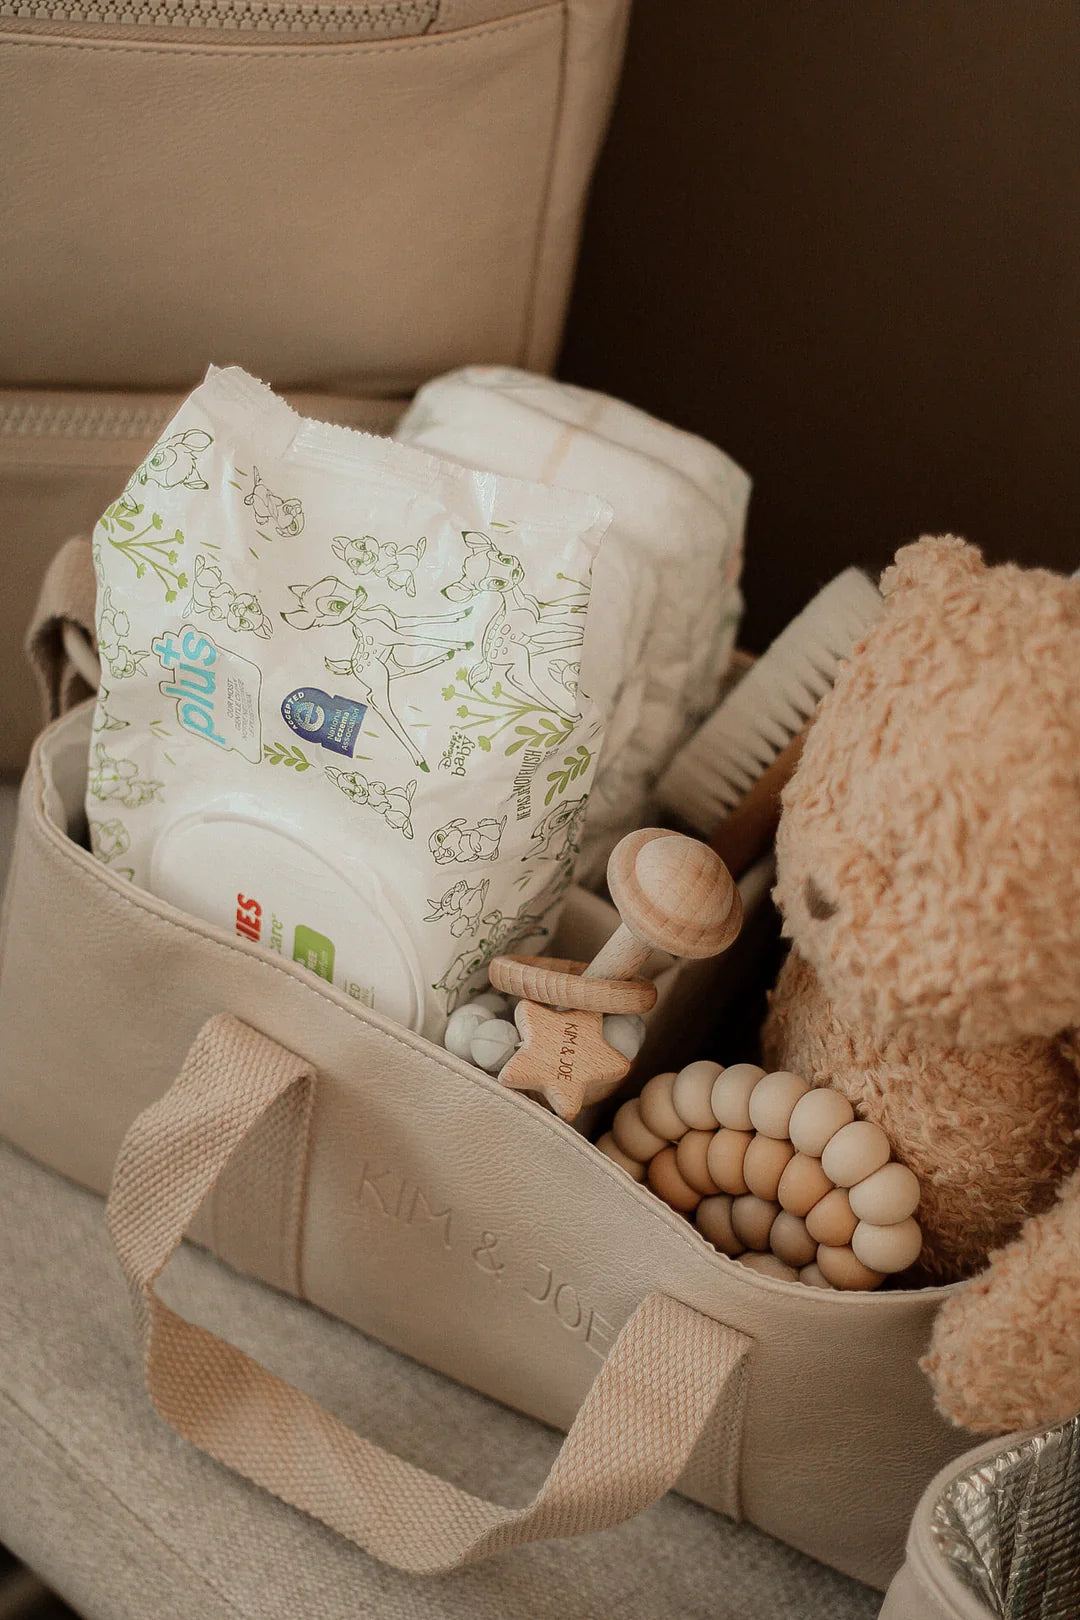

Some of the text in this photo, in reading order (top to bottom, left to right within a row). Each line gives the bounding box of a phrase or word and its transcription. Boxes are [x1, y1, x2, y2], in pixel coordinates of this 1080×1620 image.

[283, 691, 305, 730] ACCEPTED
[327, 708, 342, 740] National
[334, 711, 350, 743] Eczema
[342, 708, 360, 751] Association
[451, 735, 476, 777] baby
[519, 749, 543, 774] FLUSH
[236, 892, 263, 943] IES
[556, 1022, 578, 1082] KIM & JOE
[351, 1161, 618, 1363] KIM & JOE
